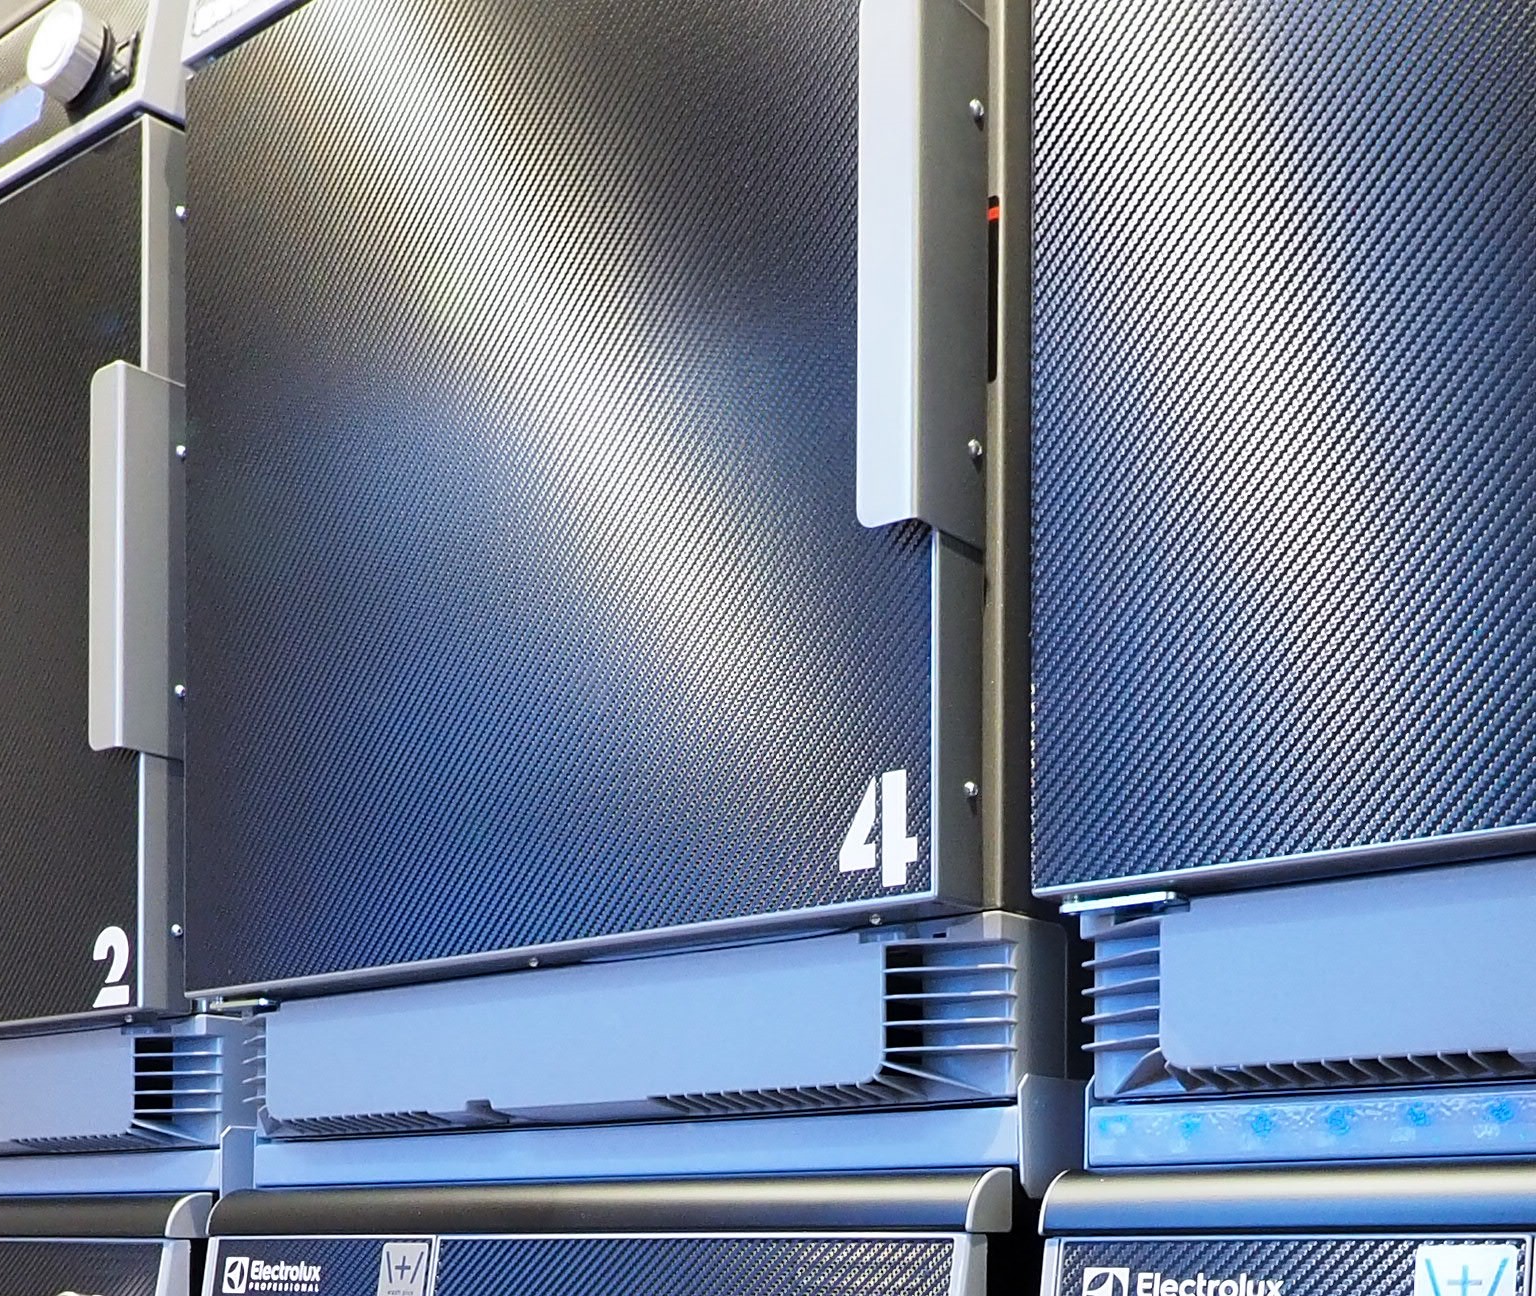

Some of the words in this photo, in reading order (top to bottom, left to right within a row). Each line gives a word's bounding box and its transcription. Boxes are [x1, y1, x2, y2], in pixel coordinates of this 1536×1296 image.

[838, 768, 918, 888] 4
[92, 925, 130, 1008] 2
[248, 1282, 320, 1293] PROFESSIONAL
[250, 1260, 322, 1282] Electrolux
